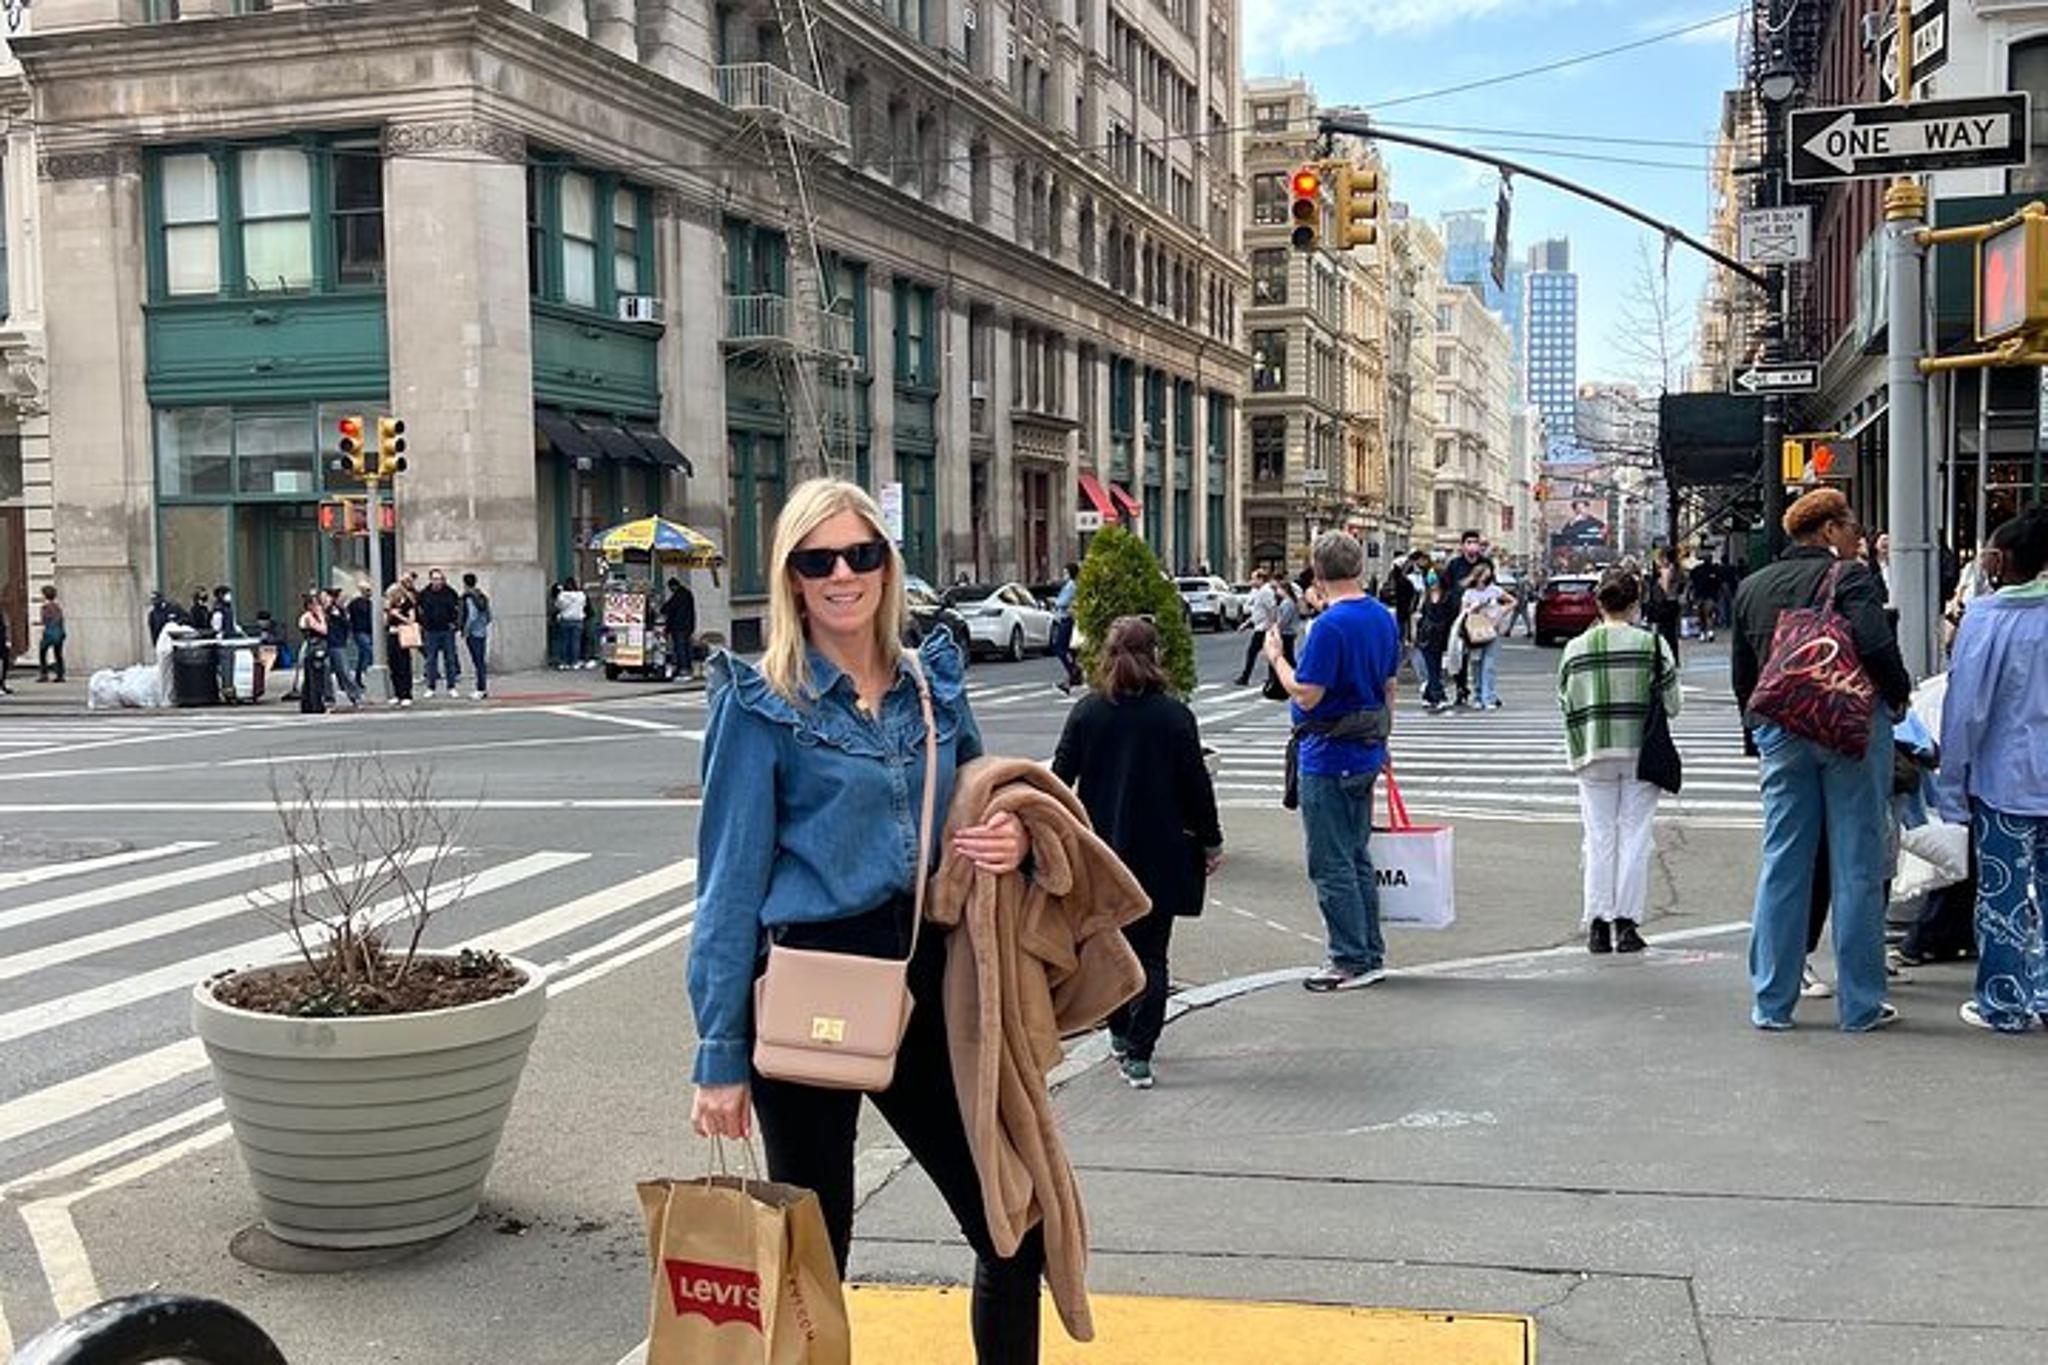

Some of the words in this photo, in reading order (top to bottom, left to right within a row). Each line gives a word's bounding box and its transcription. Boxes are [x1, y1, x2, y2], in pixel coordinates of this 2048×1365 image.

[1826, 127, 1890, 157] ONE
[1924, 118, 1995, 149] WAY
[1780, 371, 1807, 383] WAY
